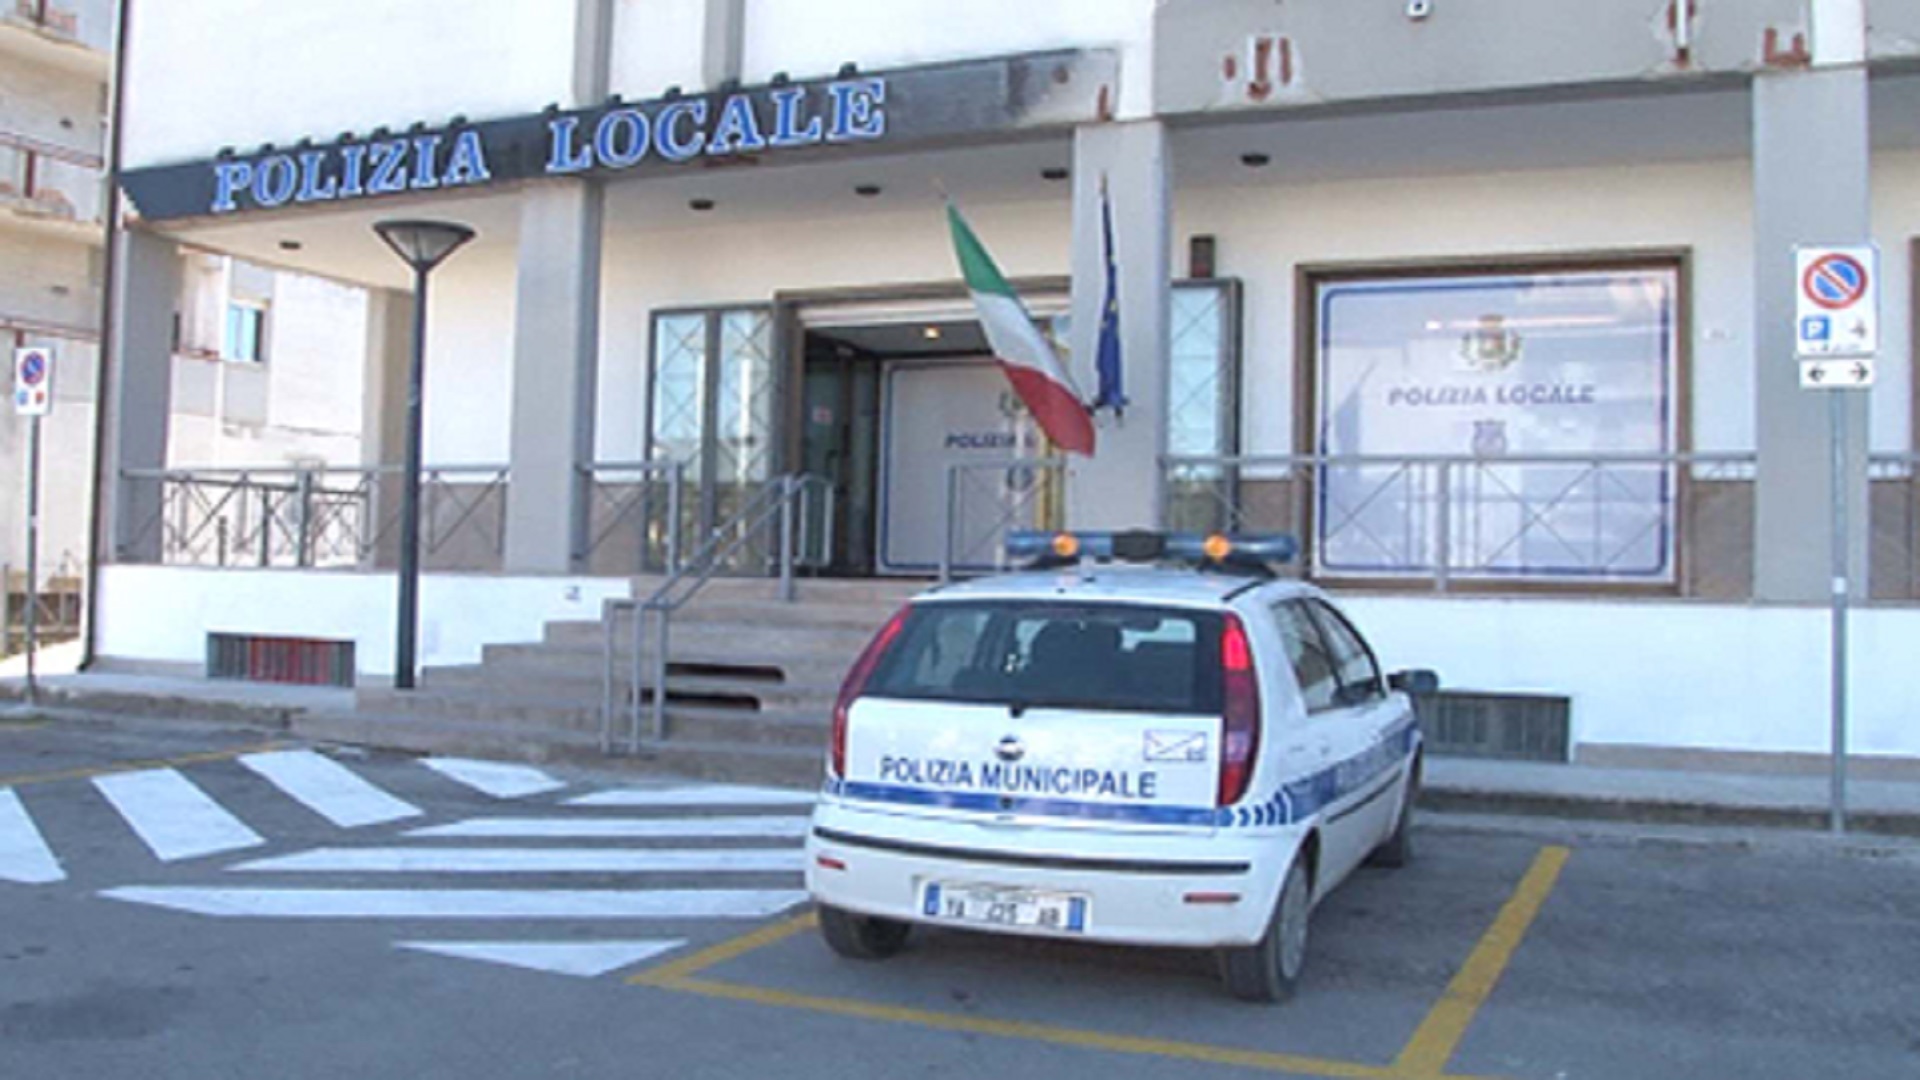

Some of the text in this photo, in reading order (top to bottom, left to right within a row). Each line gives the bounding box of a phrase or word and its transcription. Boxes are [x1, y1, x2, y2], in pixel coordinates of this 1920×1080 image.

[211, 77, 888, 213] POLIZIA LOCALE
[1388, 383, 1596, 406] POLIZIA LOCALE
[879, 755, 1157, 798] POLIZIA MUNICIPALE
